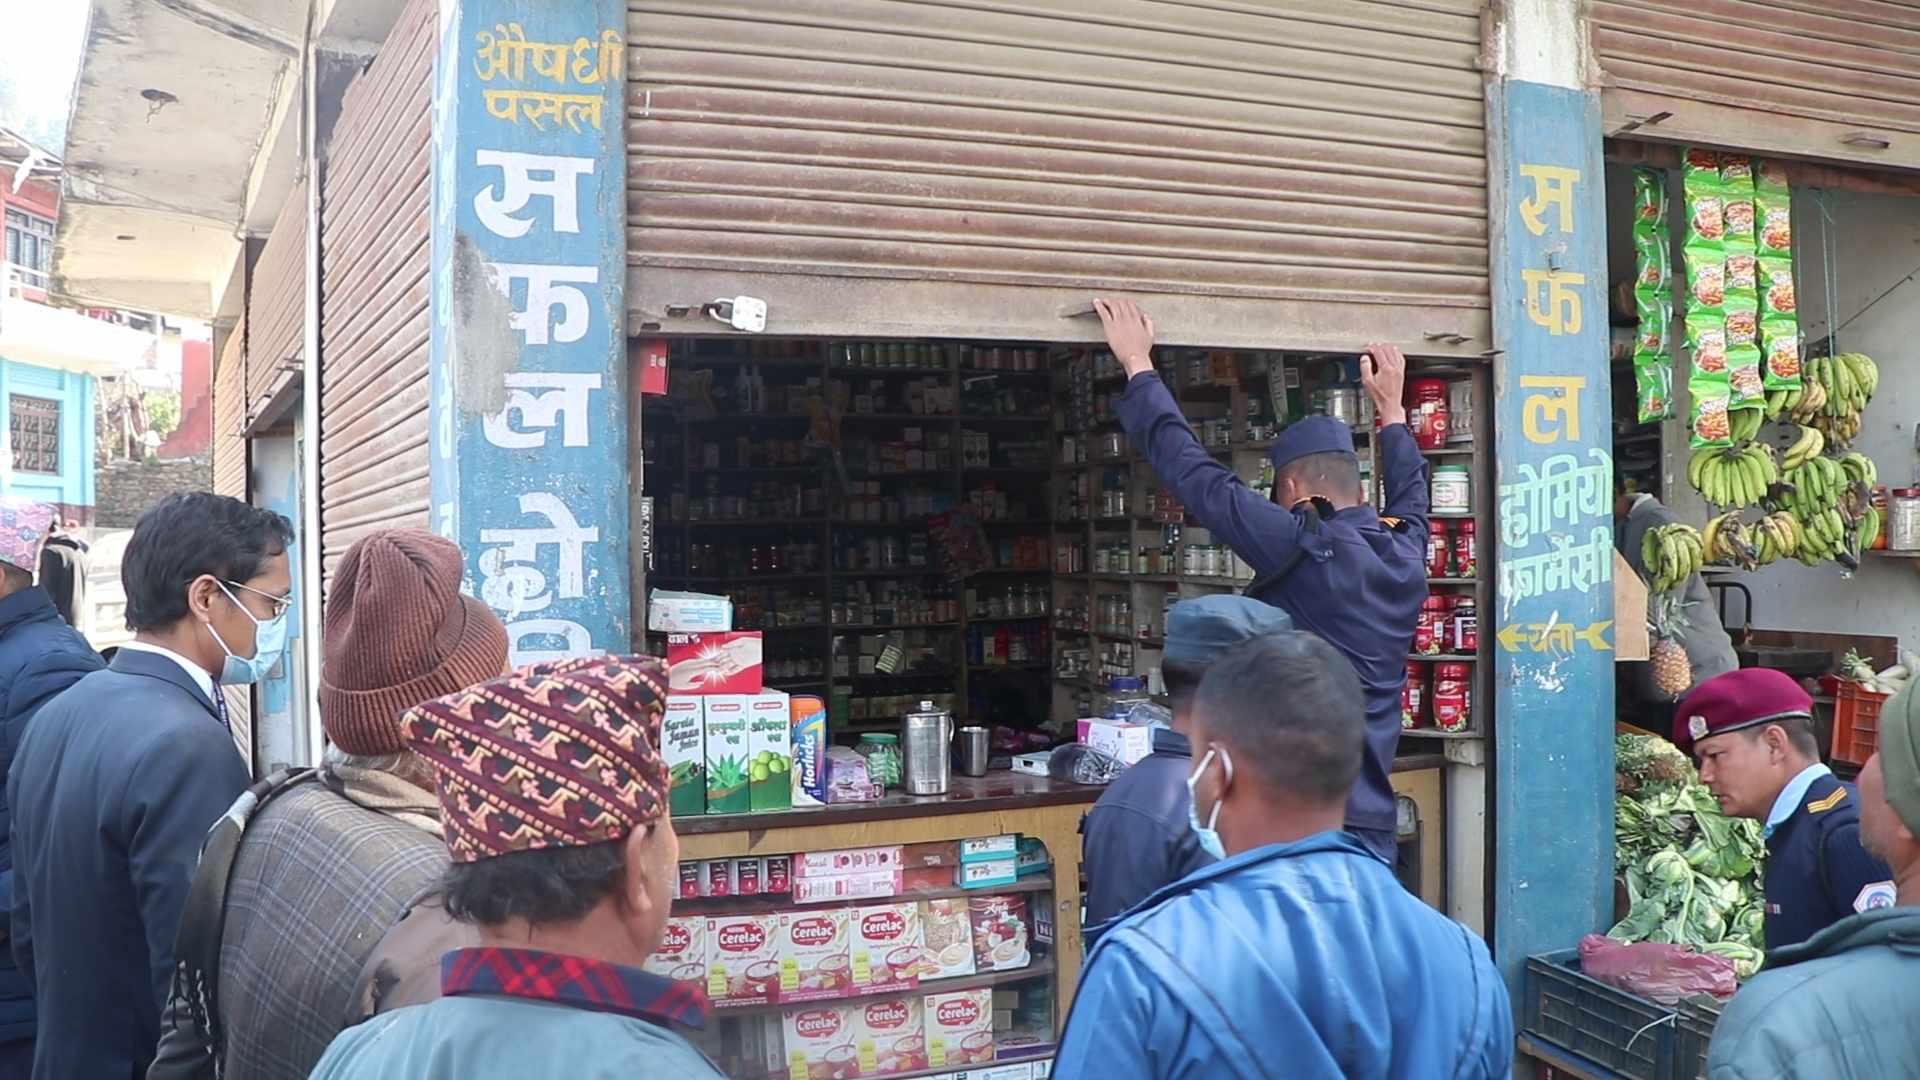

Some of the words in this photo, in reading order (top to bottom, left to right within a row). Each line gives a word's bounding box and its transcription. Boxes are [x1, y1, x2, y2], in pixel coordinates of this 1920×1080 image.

[483, 89, 604, 134] पसल
[1499, 448, 1614, 548] होमियो
[799, 733, 816, 788] Horlicks
[792, 926, 833, 939] Cerelac
[862, 920, 903, 934] Cerelac
[719, 932, 762, 945] Cerelac
[866, 1006, 905, 1022] Cerelac
[938, 1003, 977, 1020] Cerelac
[798, 1017, 838, 1032] Cerelac
